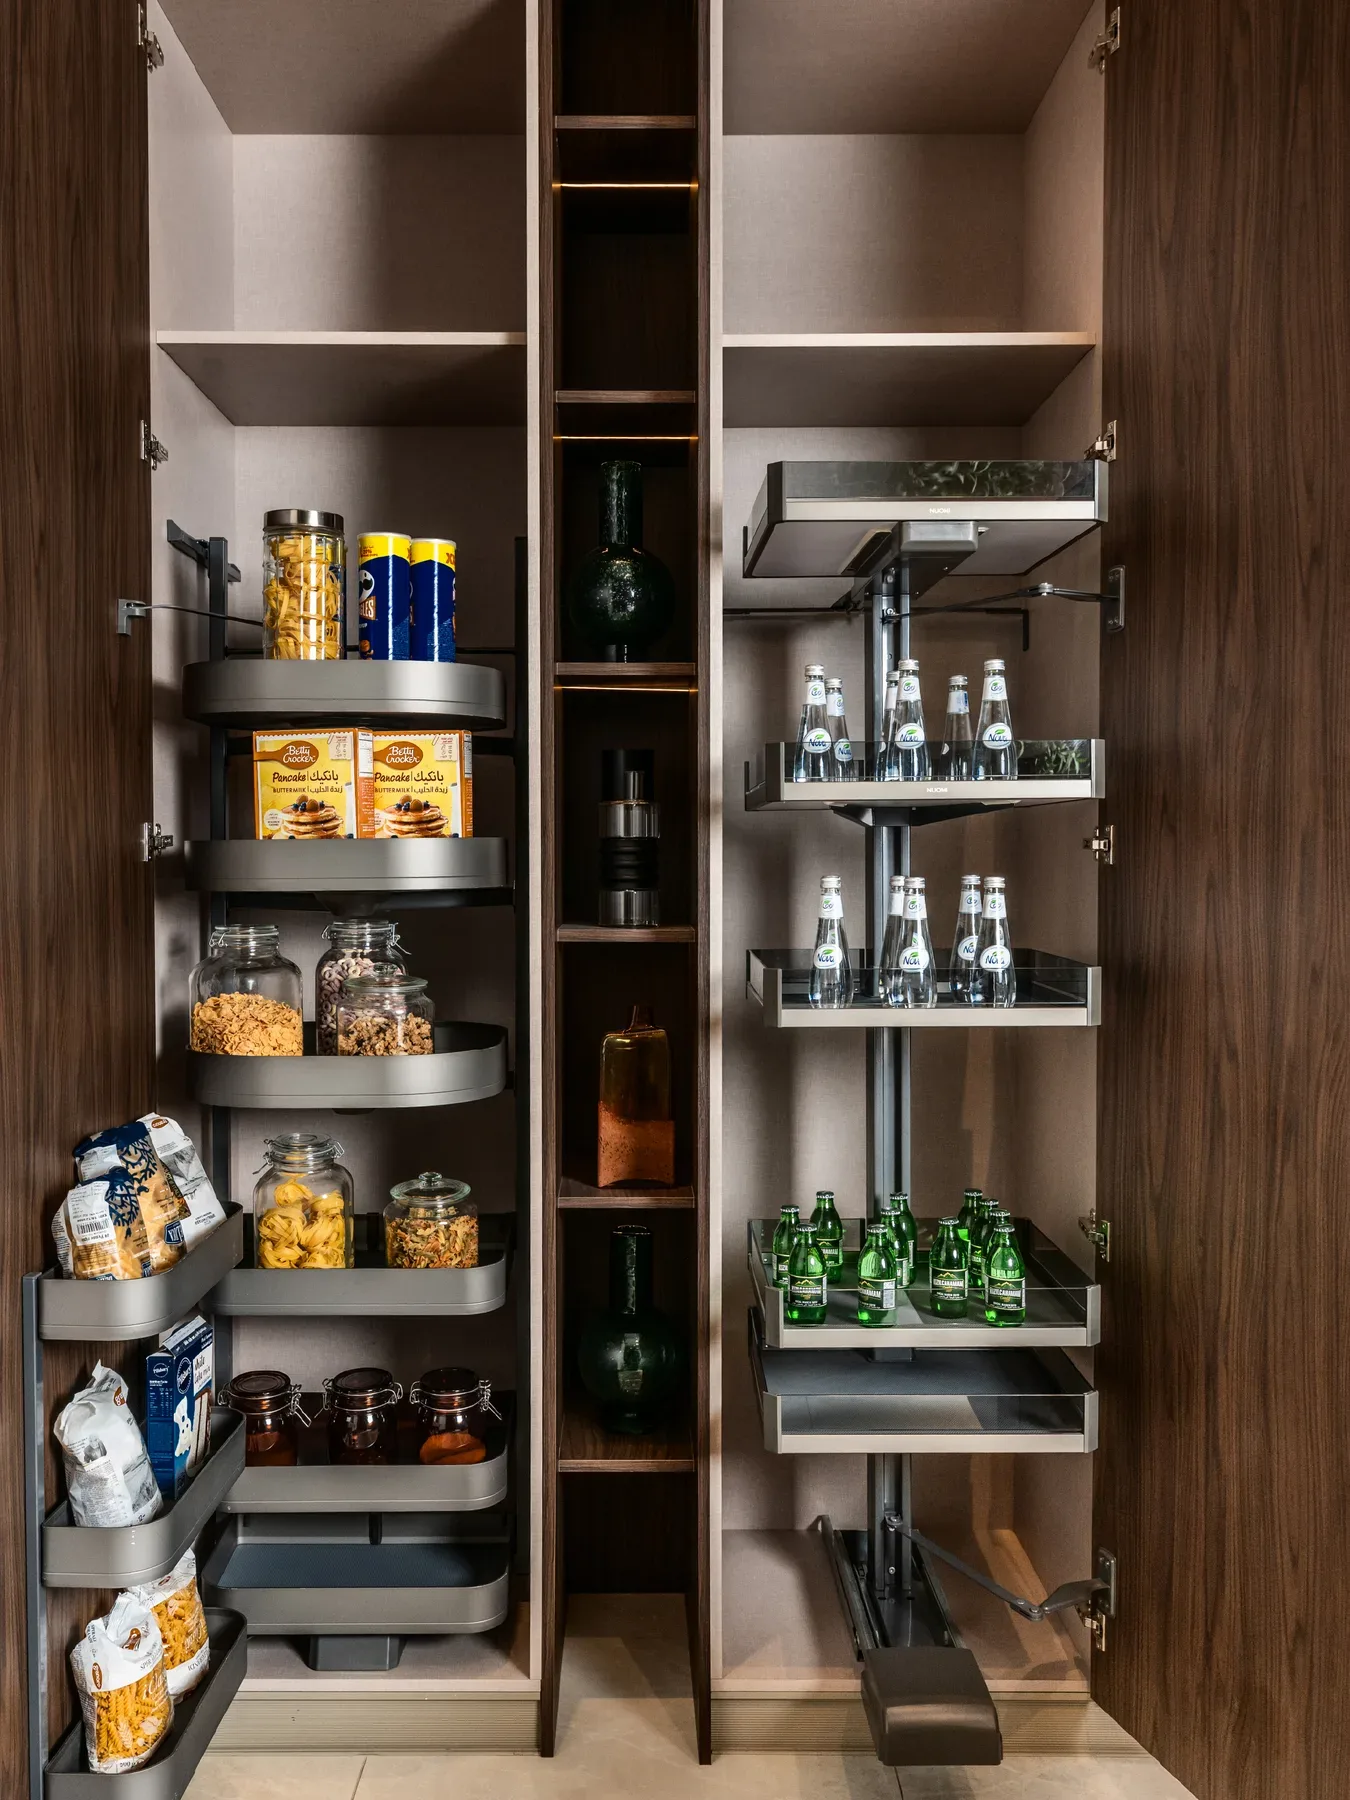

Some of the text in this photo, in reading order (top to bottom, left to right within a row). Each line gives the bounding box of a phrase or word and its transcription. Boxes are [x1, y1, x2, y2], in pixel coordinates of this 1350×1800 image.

[286, 745, 311, 756] Betty
[389, 746, 415, 757] Betty
[282, 752, 316, 764] Crocker
[385, 753, 420, 764] Crocker
[272, 771, 307, 783] Pancake
[374, 771, 411, 783] Pancake
